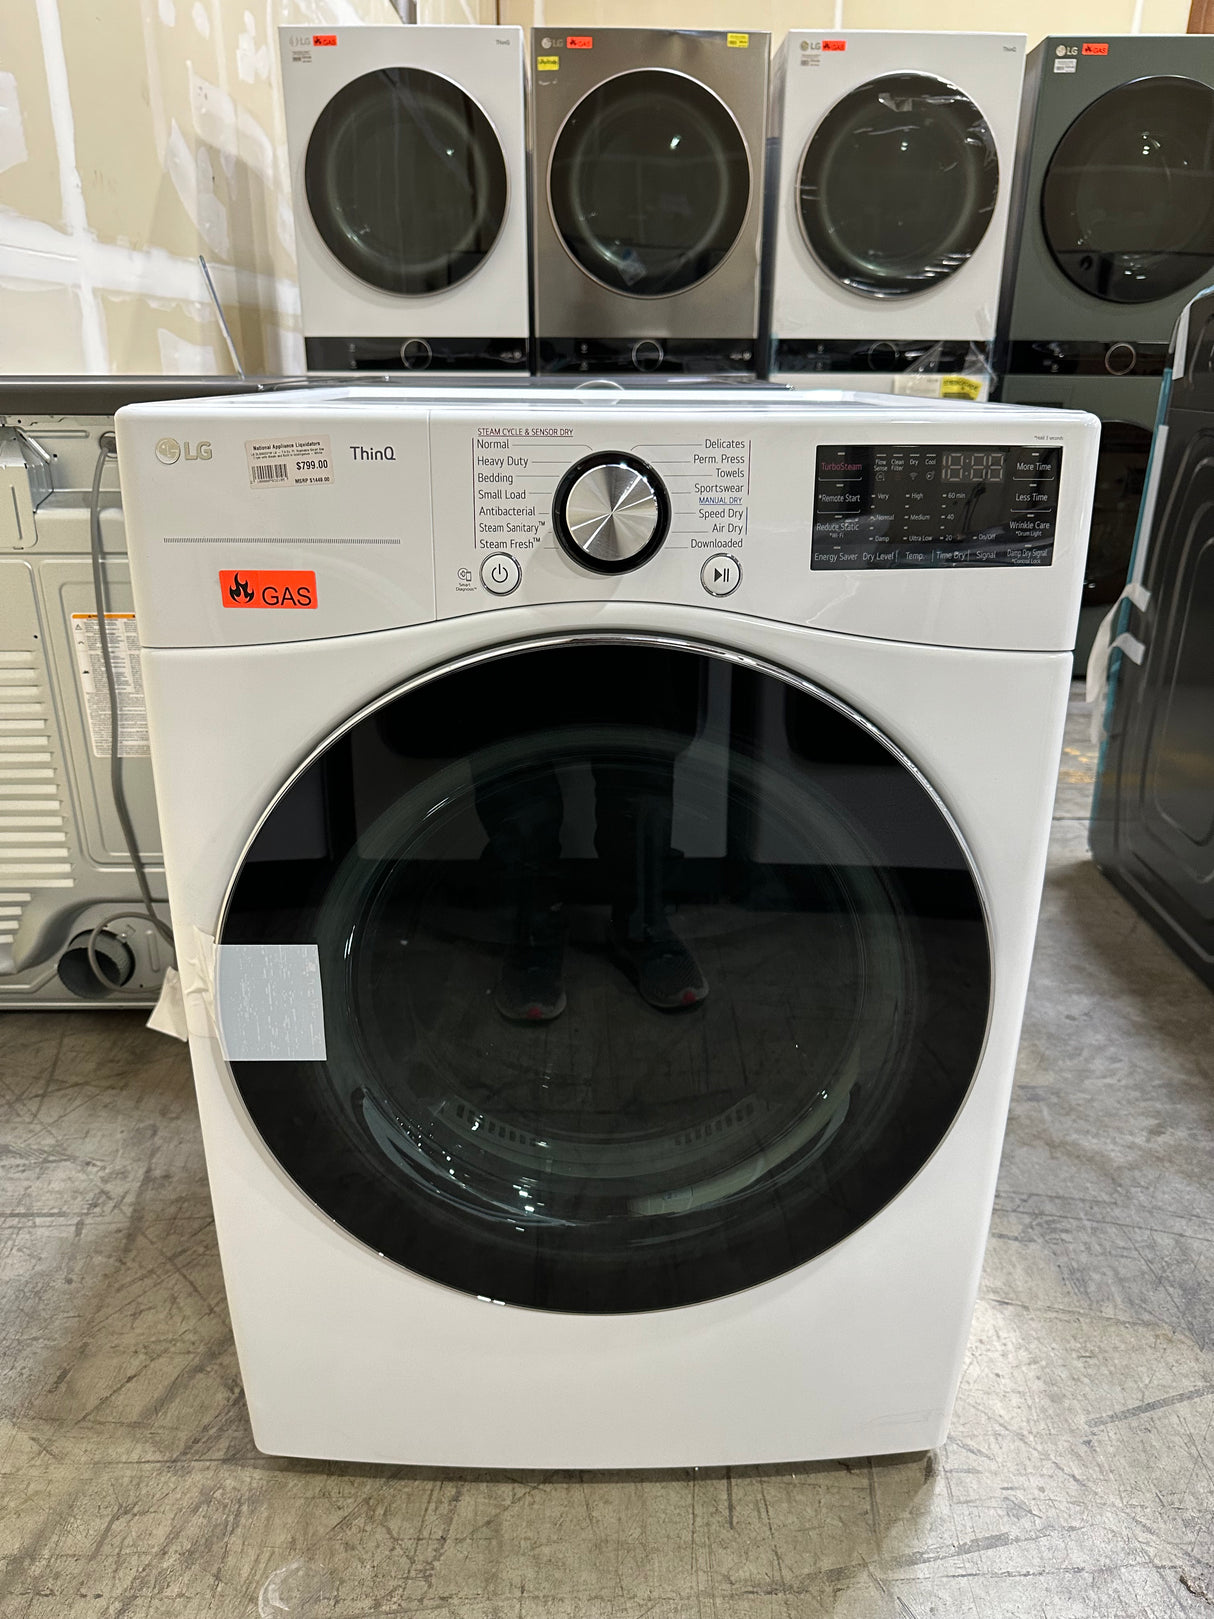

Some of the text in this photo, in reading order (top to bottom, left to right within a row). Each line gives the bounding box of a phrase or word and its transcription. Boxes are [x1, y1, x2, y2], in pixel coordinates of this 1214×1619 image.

[810, 42, 821, 50] LG
[1067, 47, 1078, 55] LG
[478, 428, 500, 436] STEAM
[502, 428, 522, 436] CYCLE
[477, 439, 509, 449] Normal
[705, 438, 745, 448] Delicates
[184, 441, 212, 460] LG
[350, 446, 396, 461] ThinQ
[478, 456, 528, 468] Heavy Duty
[694, 454, 745, 464] Perm. Press
[296, 460, 328, 470] $799.00
[822, 462, 862, 471] TurboSteam
[1017, 462, 1051, 470] More Time
[716, 468, 744, 478] Towels
[478, 473, 513, 485] Bedding
[695, 483, 744, 495] Sportswear
[479, 490, 526, 499] Small Load
[845, 494, 860, 502] Start
[1016, 493, 1048, 501] Less Time
[479, 506, 535, 516] Antibacterial
[699, 508, 743, 520] Speed Dry
[479, 523, 504, 532] Steam
[712, 523, 743, 535] Air Dry
[817, 523, 859, 531] Reduce Static
[1010, 521, 1050, 529] Wrinkle Care
[480, 539, 507, 549] Steam
[691, 538, 742, 548] Downloaded
[815, 553, 838, 562] Energy
[863, 552, 894, 562] Dry Level
[936, 551, 966, 560] Time Dry
[976, 551, 996, 560] Signal
[1007, 549, 1048, 558] Damp Dry Signal
[262, 587, 312, 606] GAS
